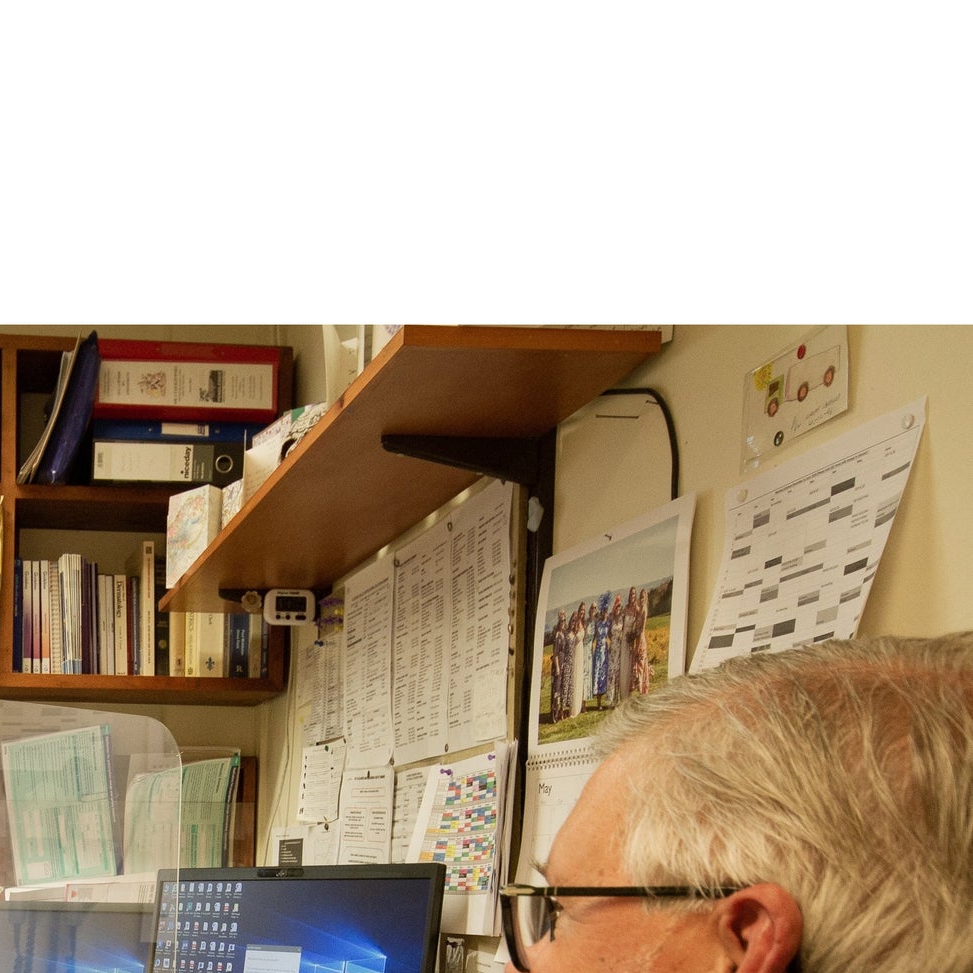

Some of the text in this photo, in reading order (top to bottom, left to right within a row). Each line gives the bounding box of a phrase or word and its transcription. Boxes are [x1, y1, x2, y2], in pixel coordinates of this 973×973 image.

[180, 447, 192, 479] niceday
[116, 581, 124, 618] Dermatology
[538, 782, 552, 796] May
